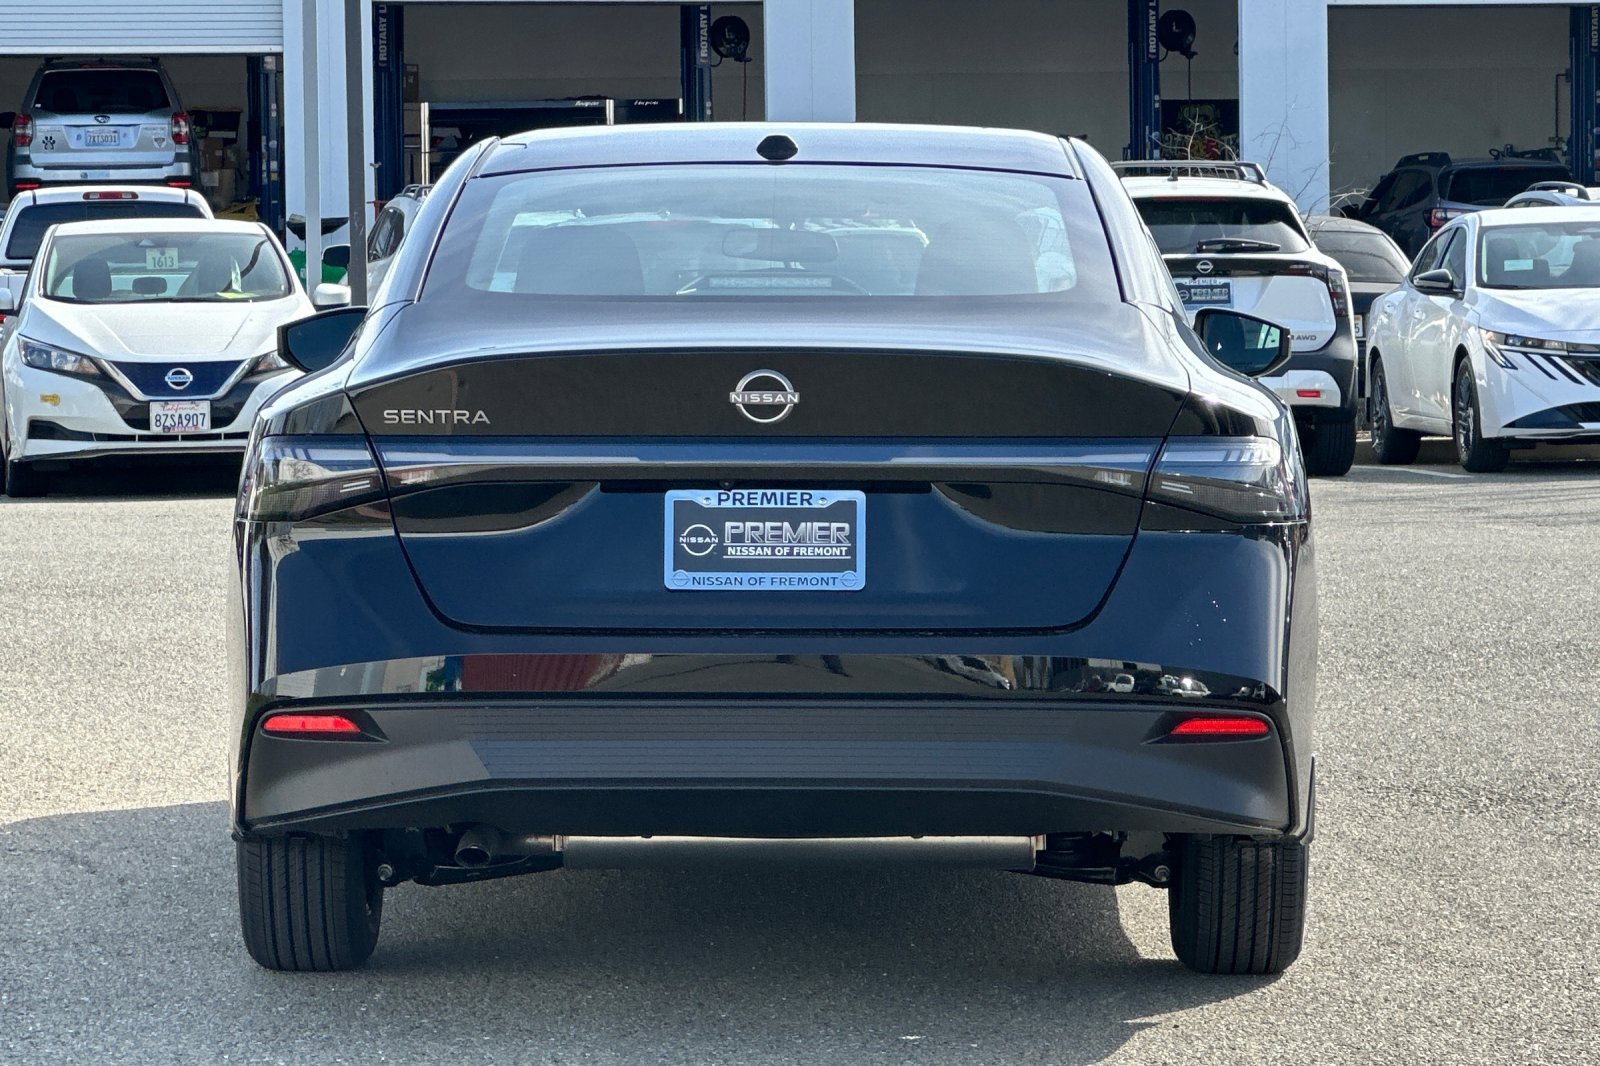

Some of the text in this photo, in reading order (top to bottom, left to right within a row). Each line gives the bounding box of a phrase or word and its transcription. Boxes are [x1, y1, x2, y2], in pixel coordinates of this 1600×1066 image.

[379, 16, 387, 61] ROTARY
[700, 13, 708, 58] ROTARY
[152, 256, 174, 268] 1613
[731, 393, 799, 403] NISSAN
[155, 412, 206, 428] 8ZSA907
[383, 409, 491, 424] SENTRA
[717, 491, 813, 507] PREMIER
[679, 536, 719, 544] NISSAN
[725, 521, 850, 544] PREMIER
[727, 546, 848, 556] NISSAN OF FREMONT
[692, 576, 743, 587] NISSAN
[747, 576, 766, 587] OF
[770, 576, 839, 587] FREMONT
